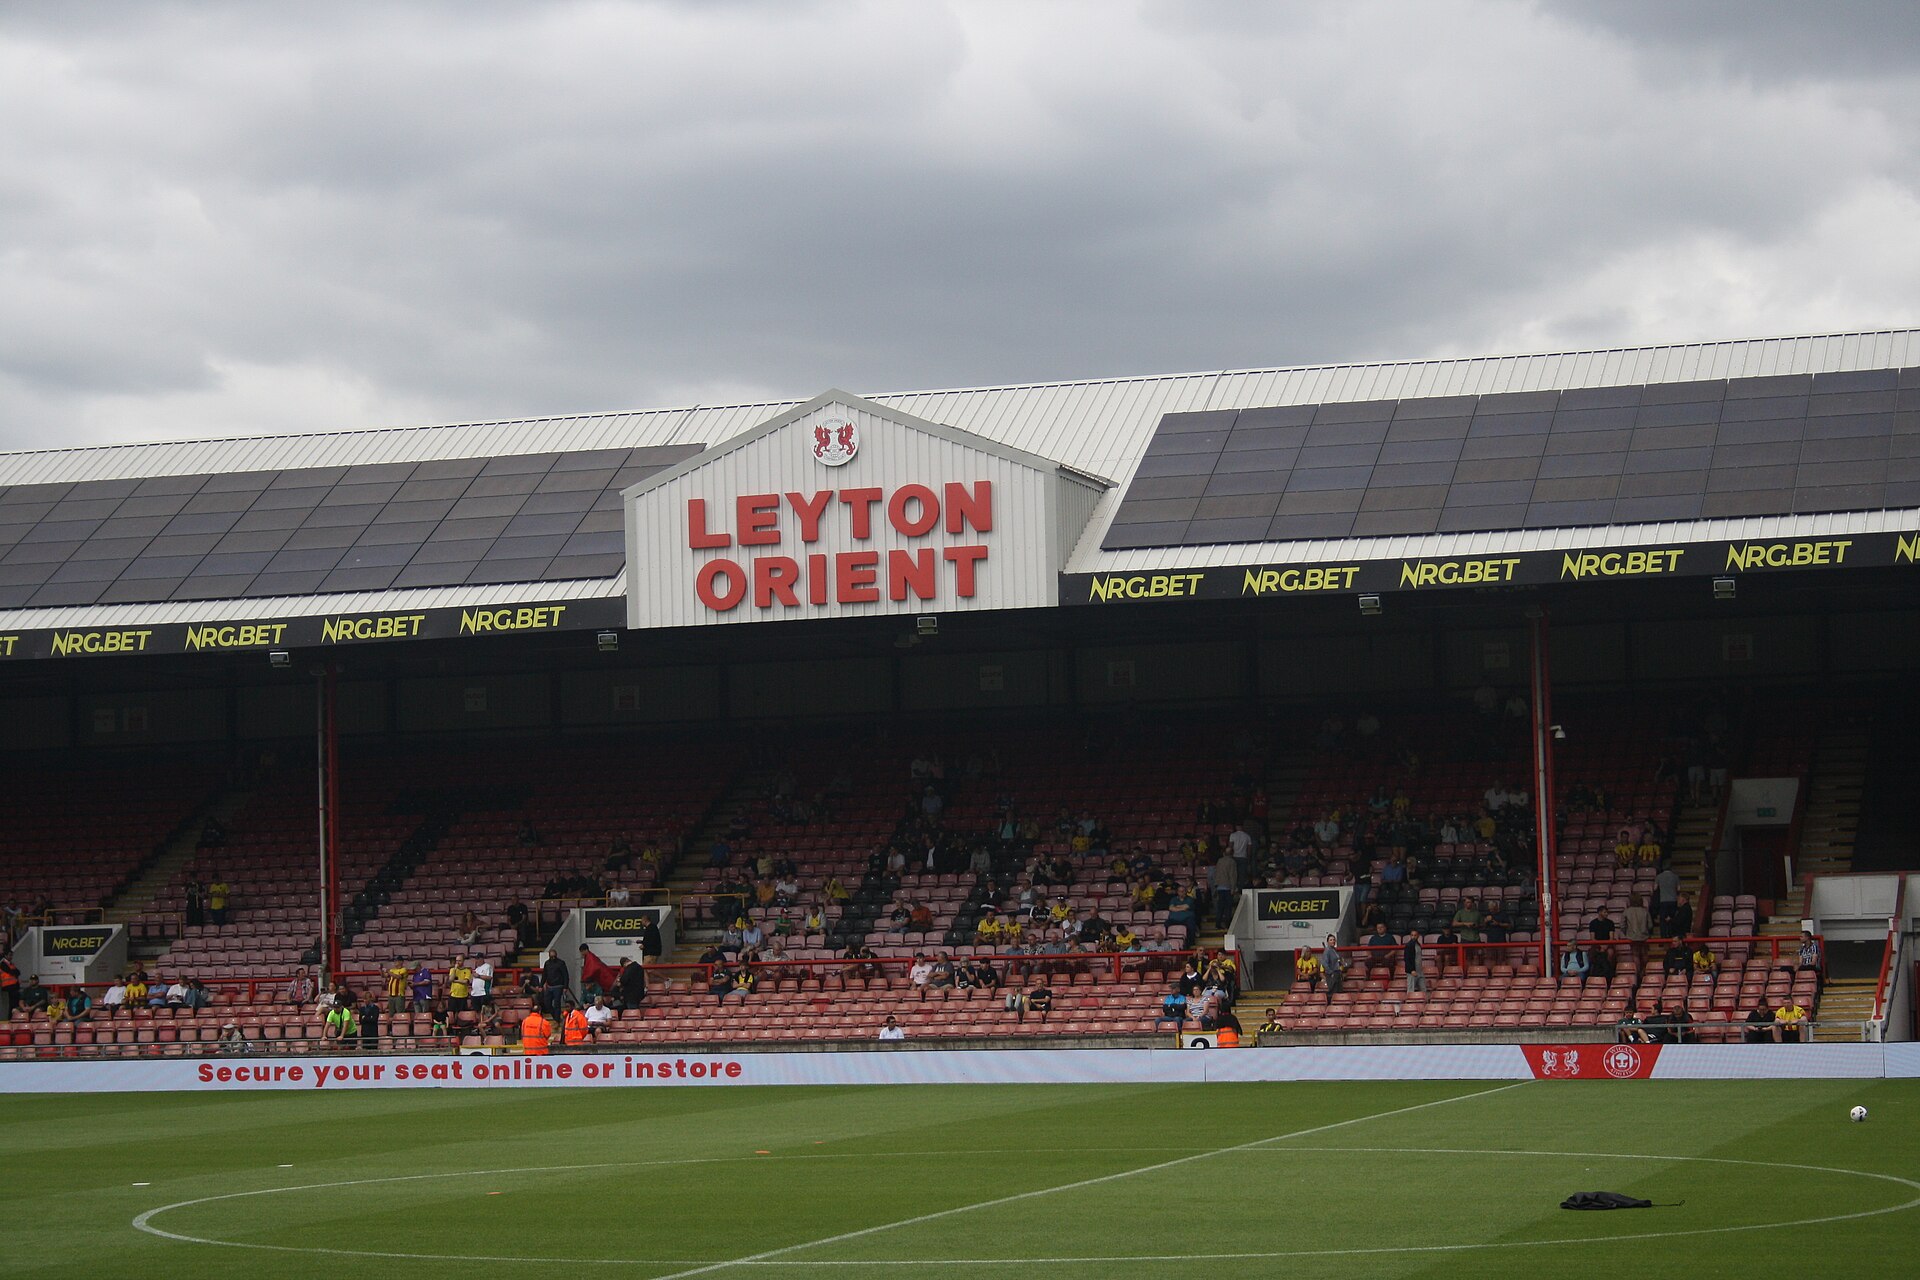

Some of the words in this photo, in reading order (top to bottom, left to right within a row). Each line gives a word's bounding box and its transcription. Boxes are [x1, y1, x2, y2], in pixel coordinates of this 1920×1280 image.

[688, 480, 992, 549] LEYTON
[1726, 541, 1853, 571] NRG.BET
[1895, 532, 1920, 563] N
[696, 545, 988, 611] ORIENT
[1400, 558, 1521, 588] NRG.BET
[1561, 550, 1685, 580] NRG.BET
[1089, 573, 1205, 602] NRG.BET
[1242, 566, 1361, 595] NRG.BET
[321, 614, 426, 642] NRG.BET
[460, 605, 567, 635] NRG.BET
[0, 636, 18, 655] T
[51, 630, 152, 655] NRG.BET
[185, 623, 288, 649] NRG.BET
[1268, 899, 1329, 915] NRG.BET
[595, 916, 646, 931] NRG.BE
[52, 936, 104, 951] NRG.BET
[1609, 1046, 1634, 1054] WIGAN
[199, 1060, 303, 1082] Secure
[314, 1065, 387, 1088] your
[396, 1061, 463, 1080] seat
[473, 1059, 577, 1080] online
[583, 1063, 614, 1079] or
[626, 1057, 741, 1078] instore
